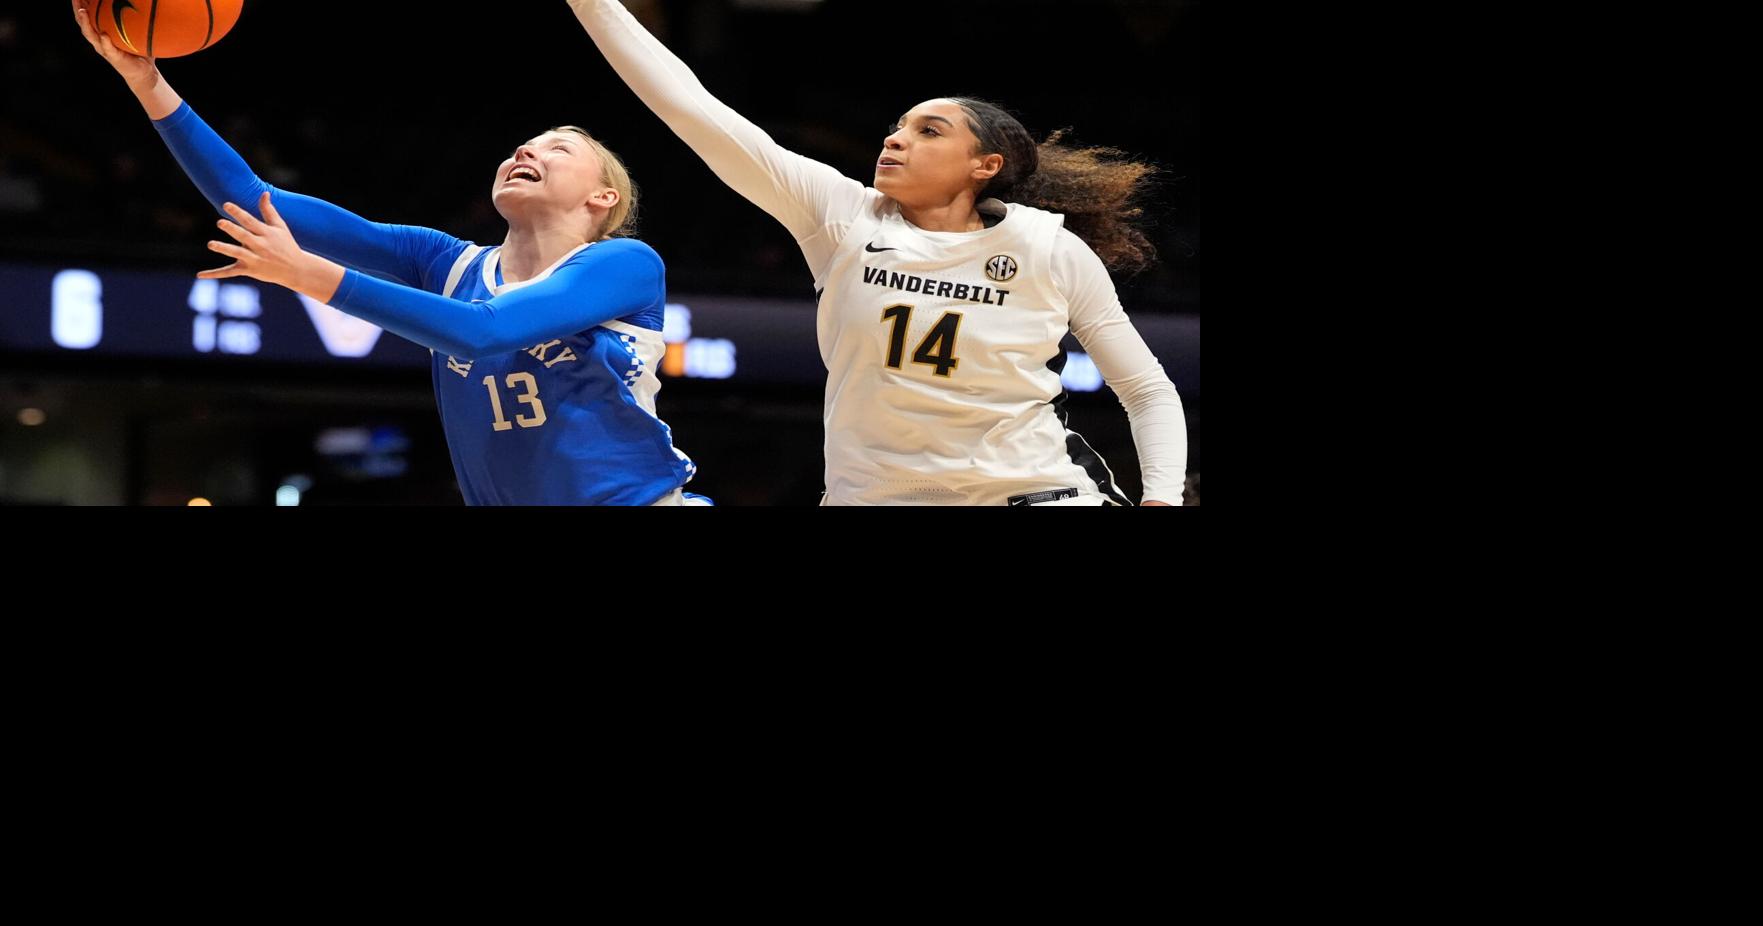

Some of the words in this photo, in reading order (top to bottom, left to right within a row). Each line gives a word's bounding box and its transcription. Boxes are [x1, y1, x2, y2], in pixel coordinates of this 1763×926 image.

[863, 266, 1010, 306] VANDERBILT
[985, 255, 1017, 280] SEC
[880, 303, 963, 378] 14
[483, 371, 547, 432] 13
